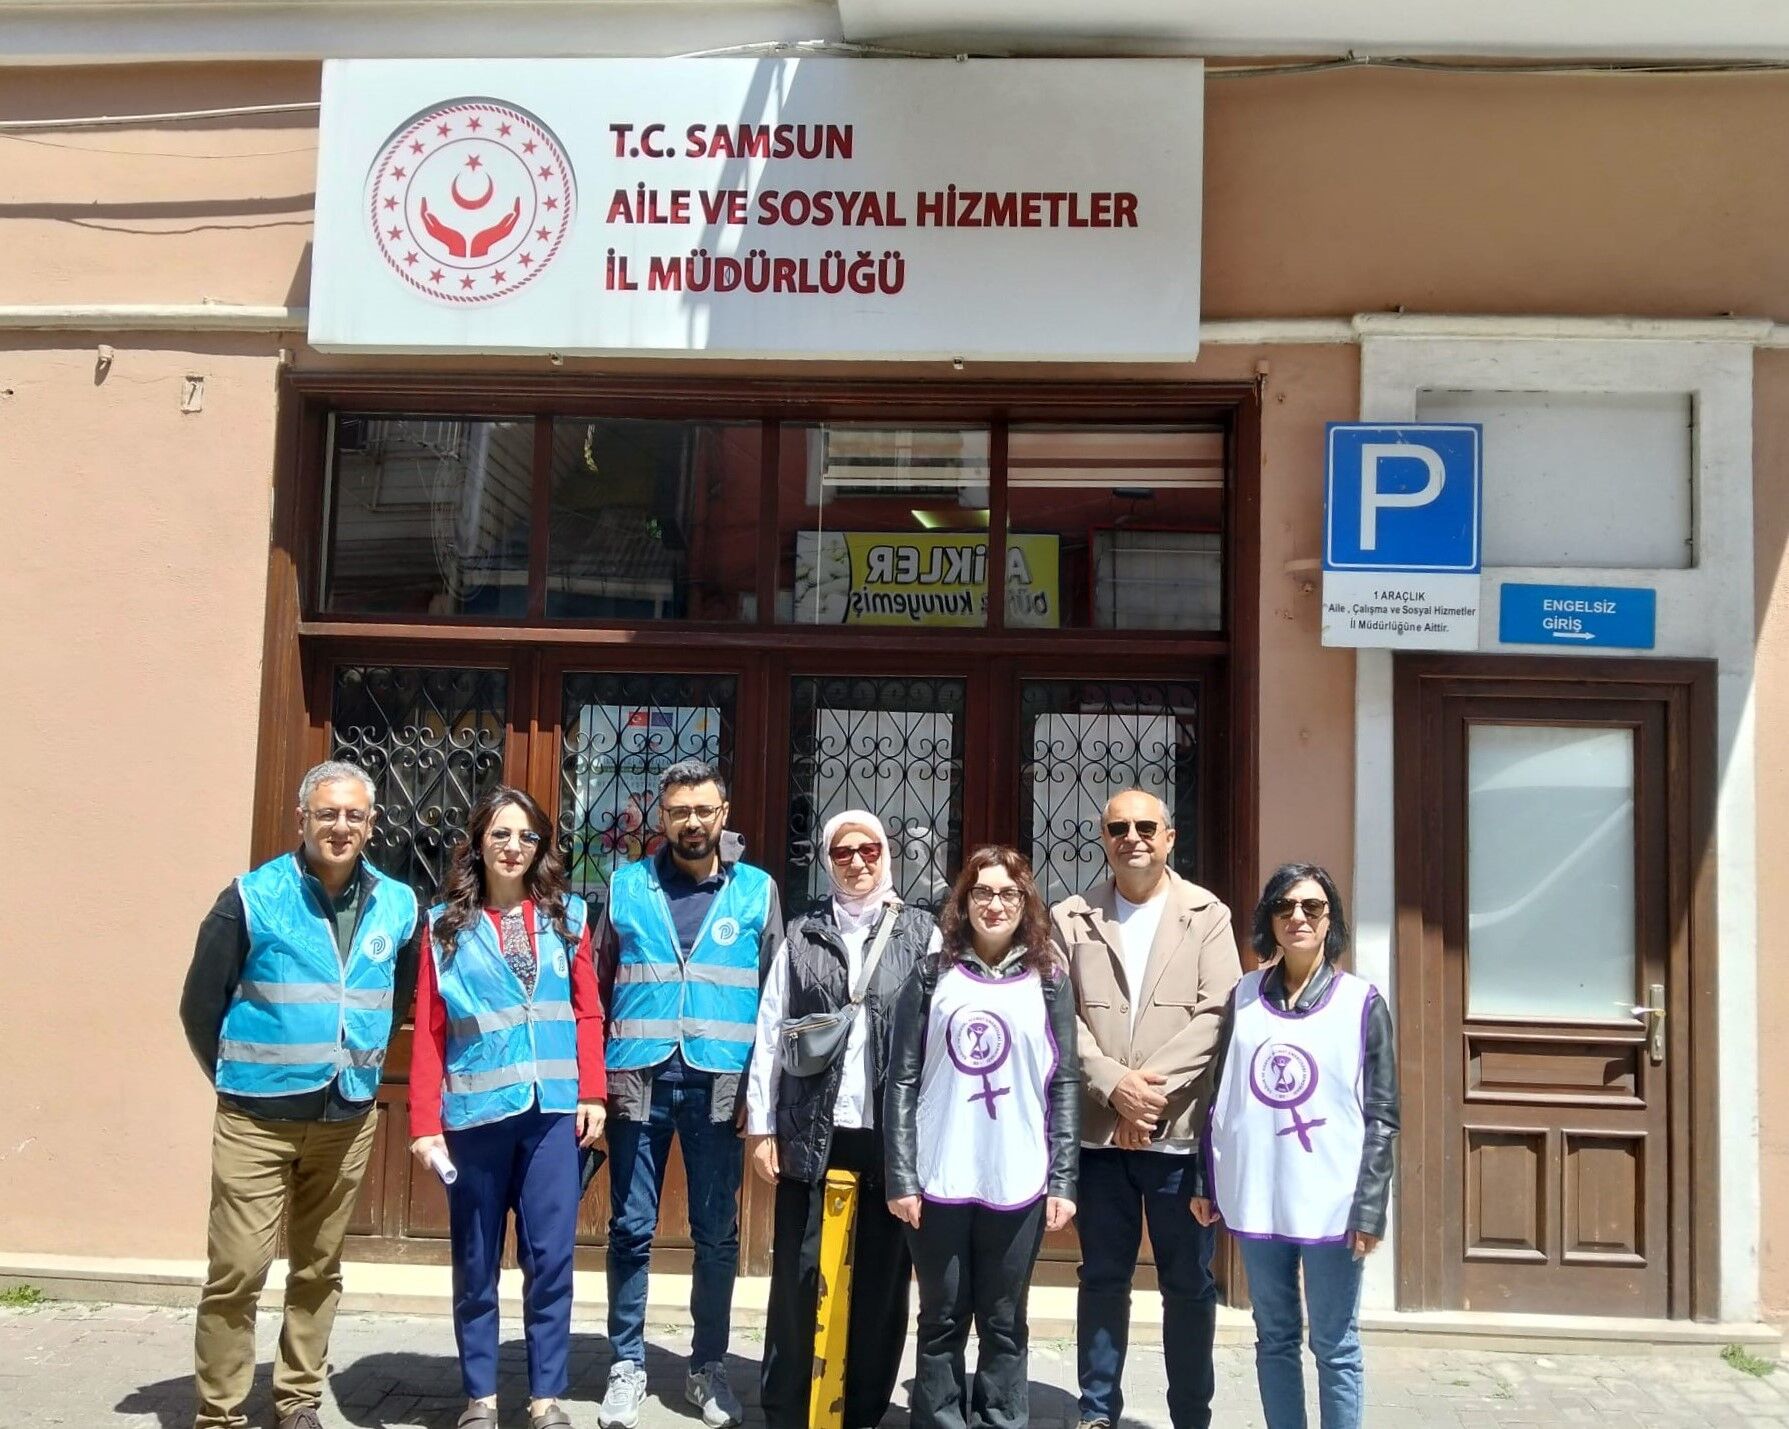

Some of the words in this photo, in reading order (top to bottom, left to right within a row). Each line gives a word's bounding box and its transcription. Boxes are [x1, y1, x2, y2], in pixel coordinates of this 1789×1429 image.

[609, 123, 676, 159] T.C.
[685, 123, 854, 160] SAMSUN
[606, 181, 691, 225] AİLE
[698, 189, 749, 225] VE
[757, 189, 907, 227] SOSYAL
[916, 182, 1139, 228] HİZMETLER
[605, 247, 639, 291] İL
[647, 248, 905, 296] MÜDÜRLÜĞÜ
[1359, 443, 1447, 551] P
[1328, 603, 1346, 613] Aile
[1352, 604, 1388, 615] Çalışma
[1391, 606, 1400, 614] ve
[1402, 605, 1432, 617] Sosyal
[1434, 605, 1476, 616] Hizmetler
[1373, 591, 1378, 600] 1
[1380, 591, 1426, 603] ARAÇLIK
[1543, 599, 1617, 614] ENGELSİZ
[1542, 615, 1582, 633] GİRİŞ
